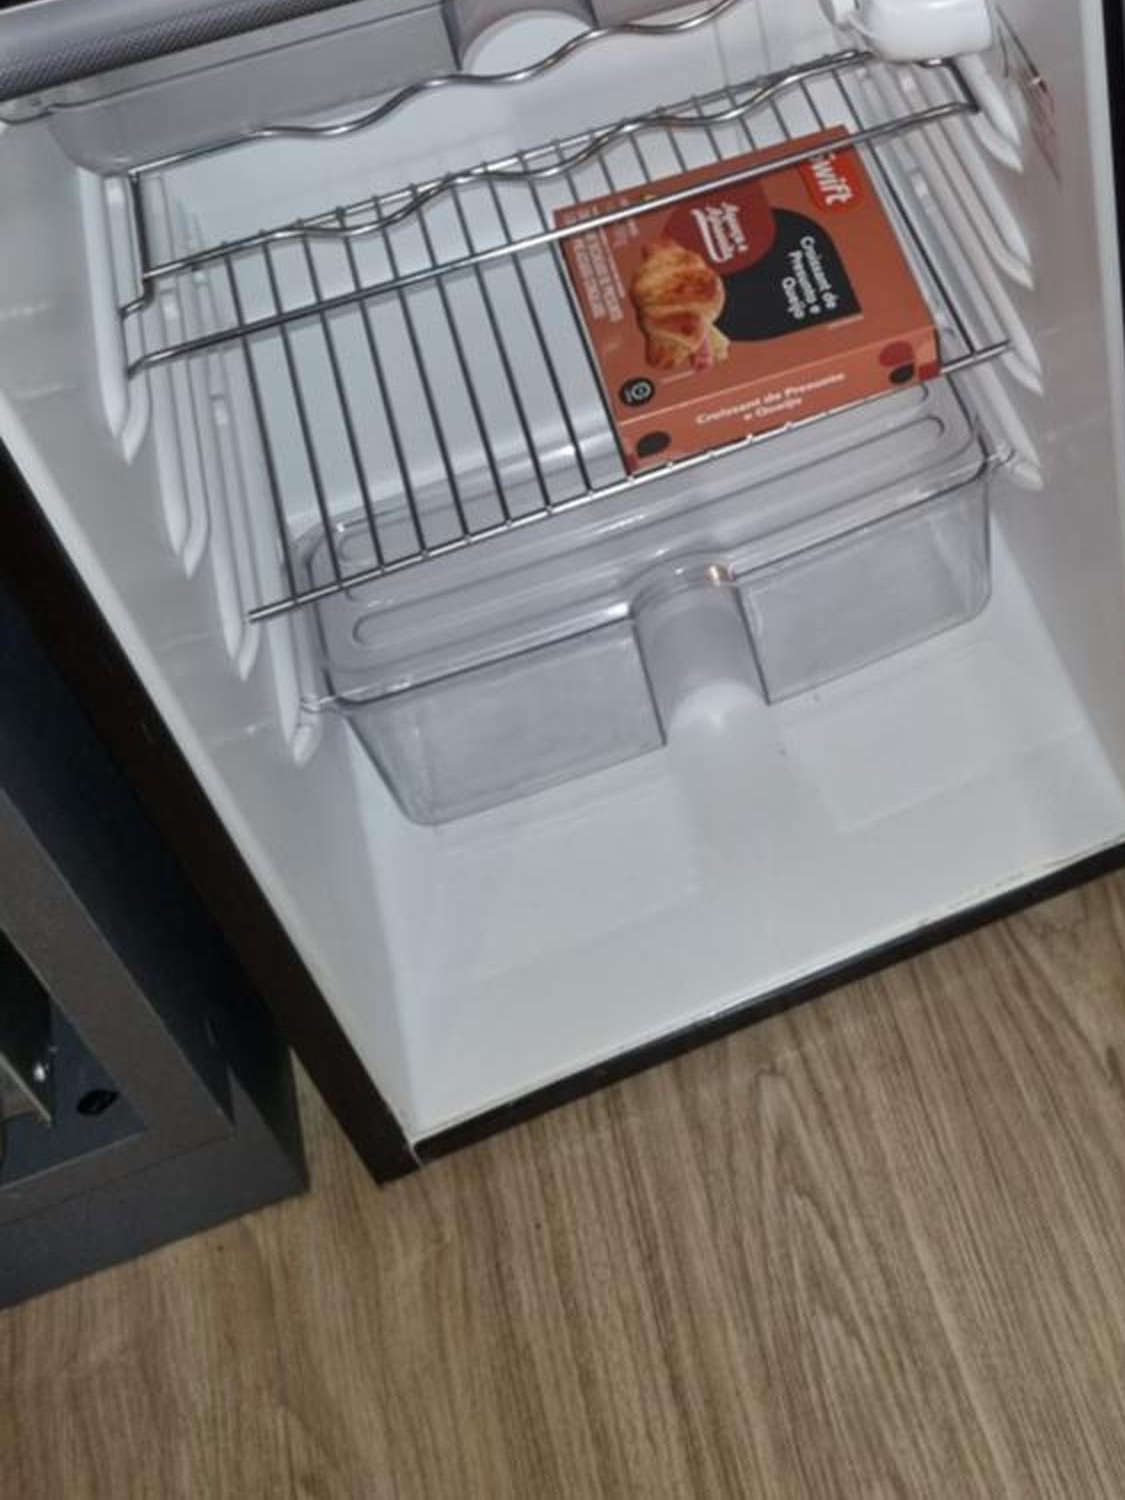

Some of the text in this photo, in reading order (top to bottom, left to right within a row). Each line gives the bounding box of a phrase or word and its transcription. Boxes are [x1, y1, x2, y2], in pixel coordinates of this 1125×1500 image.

[781, 276, 809, 320] Queijo
[786, 248, 821, 315] Presunto e
[800, 235, 839, 310] Croissant de
[695, 395, 761, 426] Croissant
[763, 389, 783, 404] de
